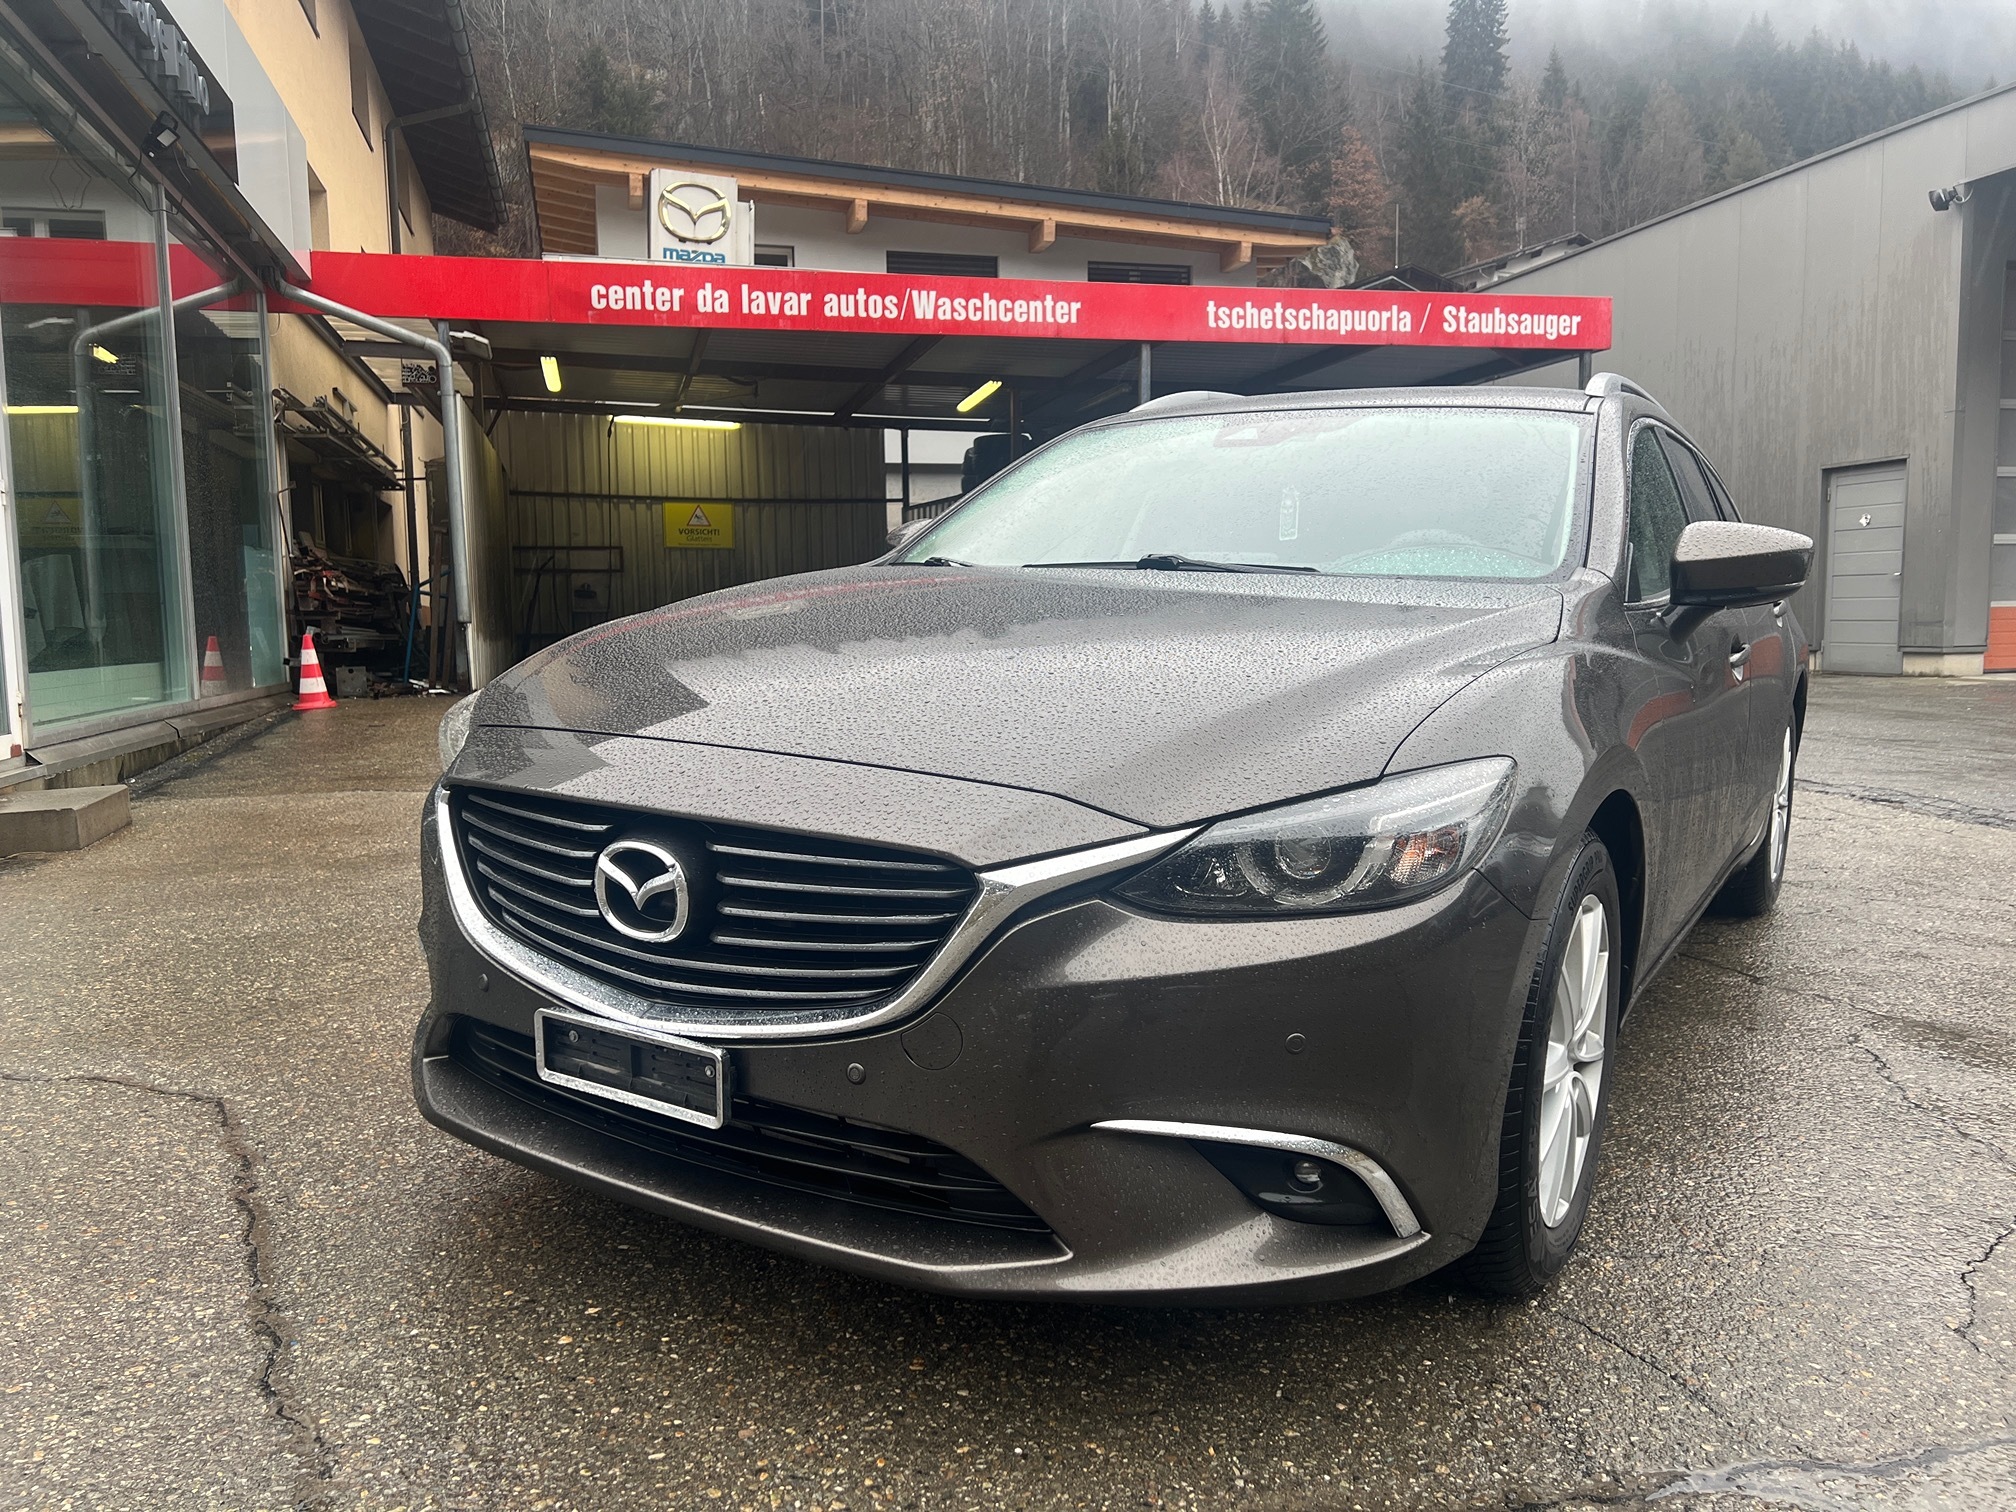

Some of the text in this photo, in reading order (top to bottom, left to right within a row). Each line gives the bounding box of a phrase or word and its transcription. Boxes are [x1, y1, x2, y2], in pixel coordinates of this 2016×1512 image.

[662, 247, 726, 264] mazda
[590, 279, 685, 312] center
[696, 282, 730, 314] da
[741, 283, 812, 316] lavar
[1206, 300, 1582, 340] tschetschapuorla / Staubsauger
[678, 528, 721, 536] VORSICHT!
